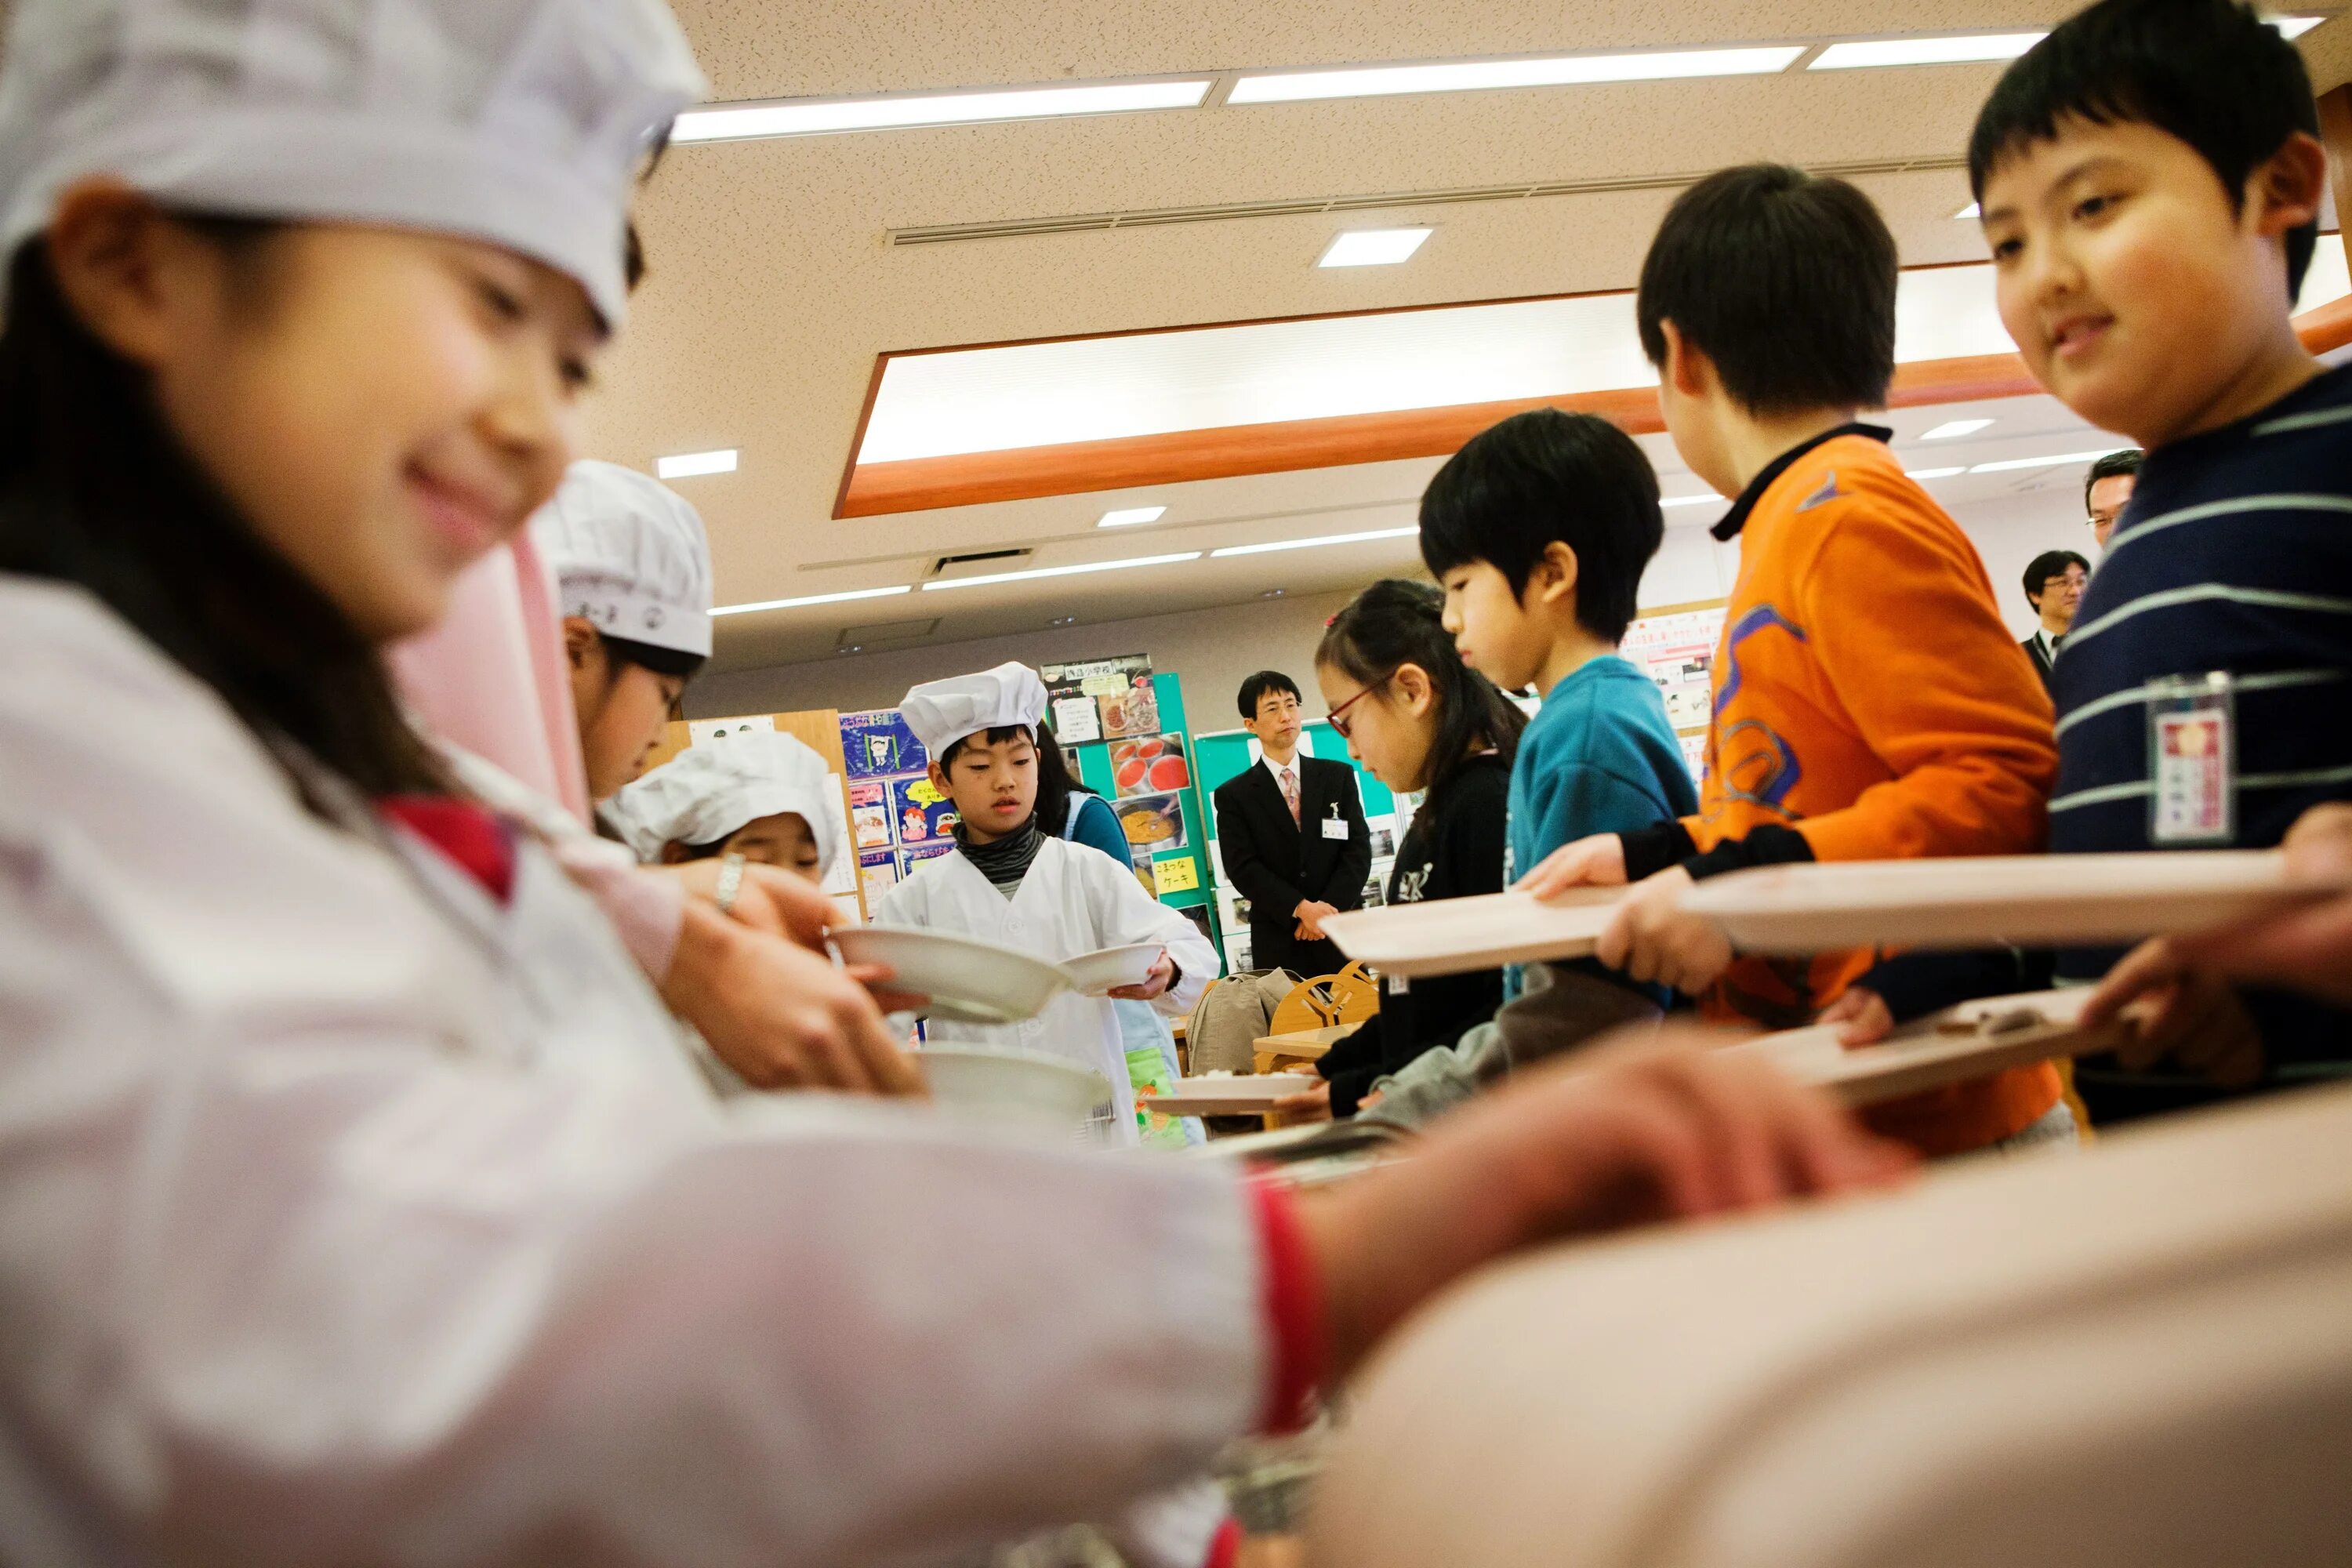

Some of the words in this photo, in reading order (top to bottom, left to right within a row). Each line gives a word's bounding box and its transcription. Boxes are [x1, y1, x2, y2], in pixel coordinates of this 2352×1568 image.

[1156, 860, 1186, 873] こまつな
[1164, 874, 1189, 887] ケーキ
